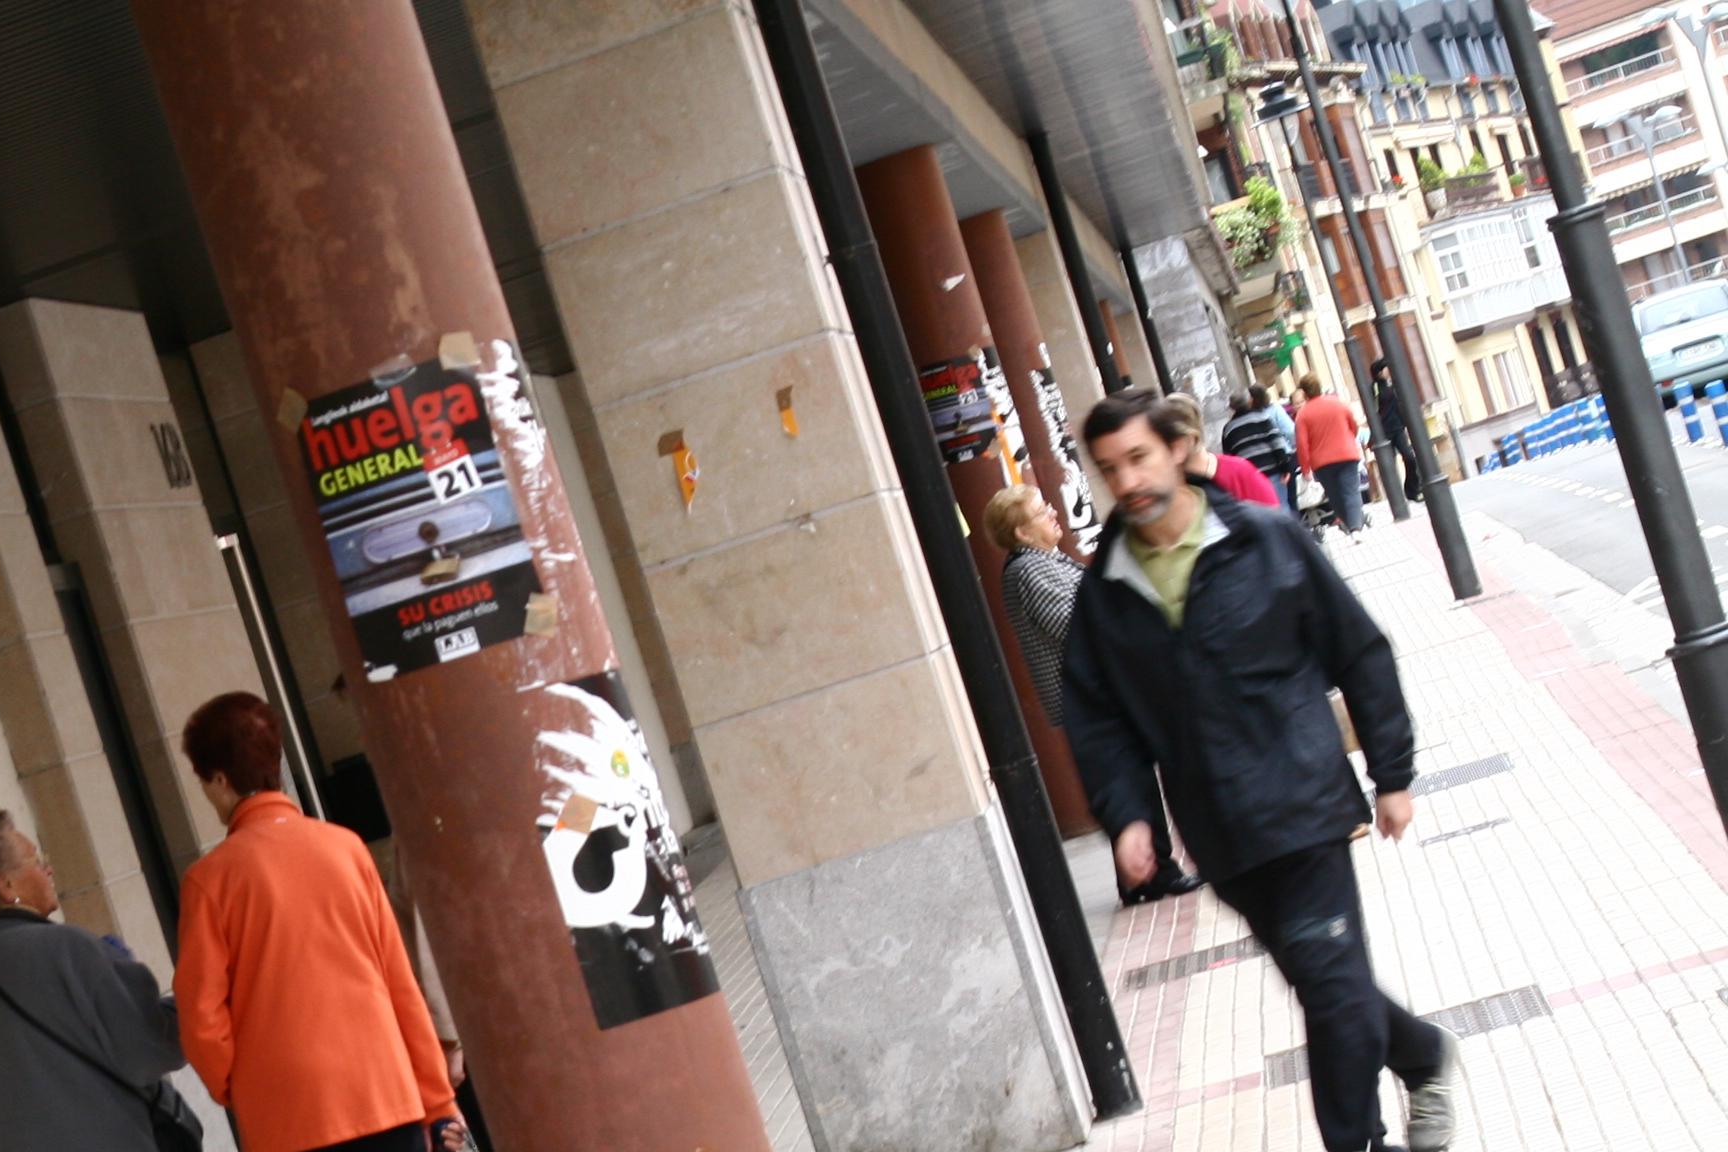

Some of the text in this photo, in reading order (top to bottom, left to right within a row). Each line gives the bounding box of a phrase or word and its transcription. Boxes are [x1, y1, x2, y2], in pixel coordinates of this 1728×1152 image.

[303, 383, 479, 471] huelga
[319, 443, 425, 497] GENERAL
[437, 460, 474, 499] 21
[398, 580, 494, 629] SU CRISIS
